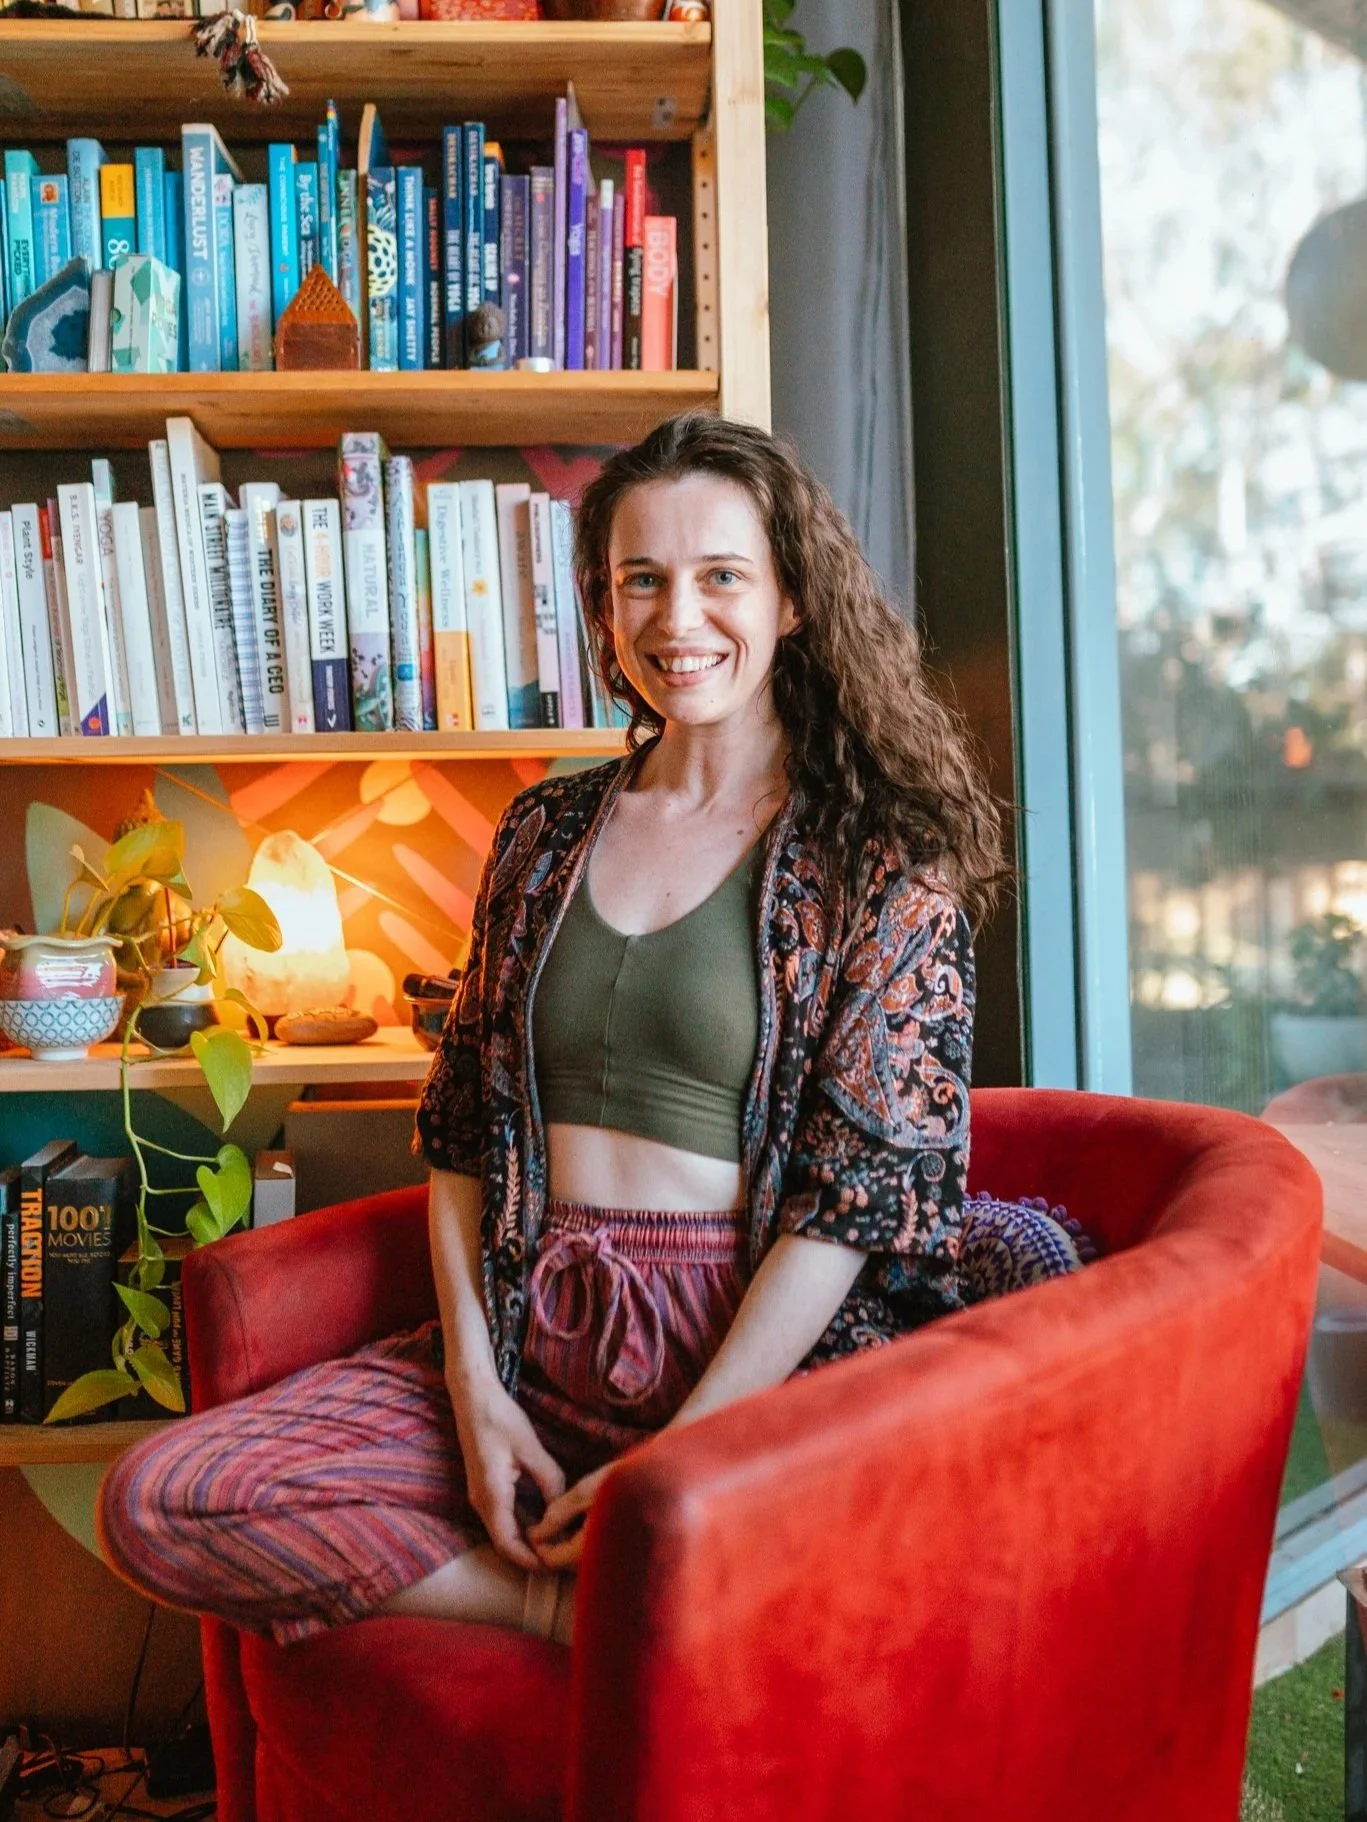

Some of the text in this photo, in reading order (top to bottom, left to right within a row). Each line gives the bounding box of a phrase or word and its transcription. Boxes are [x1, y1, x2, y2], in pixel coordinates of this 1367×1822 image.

[278, 156, 287, 172] THE
[298, 174, 312, 190] By
[190, 147, 208, 260] WANDERLUST
[301, 192, 314, 213] the
[301, 214, 313, 235] Sea
[405, 176, 415, 286] THINK LIKE A MONK
[646, 231, 668, 297] BODY
[406, 296, 416, 361] JAY SHETTY
[202, 492, 217, 520] MAIN
[312, 507, 327, 529] THE
[22, 521, 34, 579] Plant Style
[72, 524, 84, 565] IYENGAR
[99, 511, 114, 557] YOGA
[204, 526, 225, 560] STREET
[257, 549, 273, 576] THE
[435, 505, 452, 628] Digestive Wellness
[362, 543, 379, 618] NATURAL
[260, 581, 277, 623] DIARY
[316, 581, 333, 616] WORK
[264, 629, 280, 648] OF
[318, 619, 335, 654] WEEK
[267, 652, 281, 661] A
[268, 666, 284, 694] CEO
[47, 1205, 111, 1231] 1001
[21, 1188, 42, 1298] TRACTION
[48, 1232, 112, 1246] MOVIES
[6, 1223, 17, 1320] perfectly imperfect
[25, 1330, 36, 1371] WICKMAN
[172, 1339, 182, 1363] GAME
